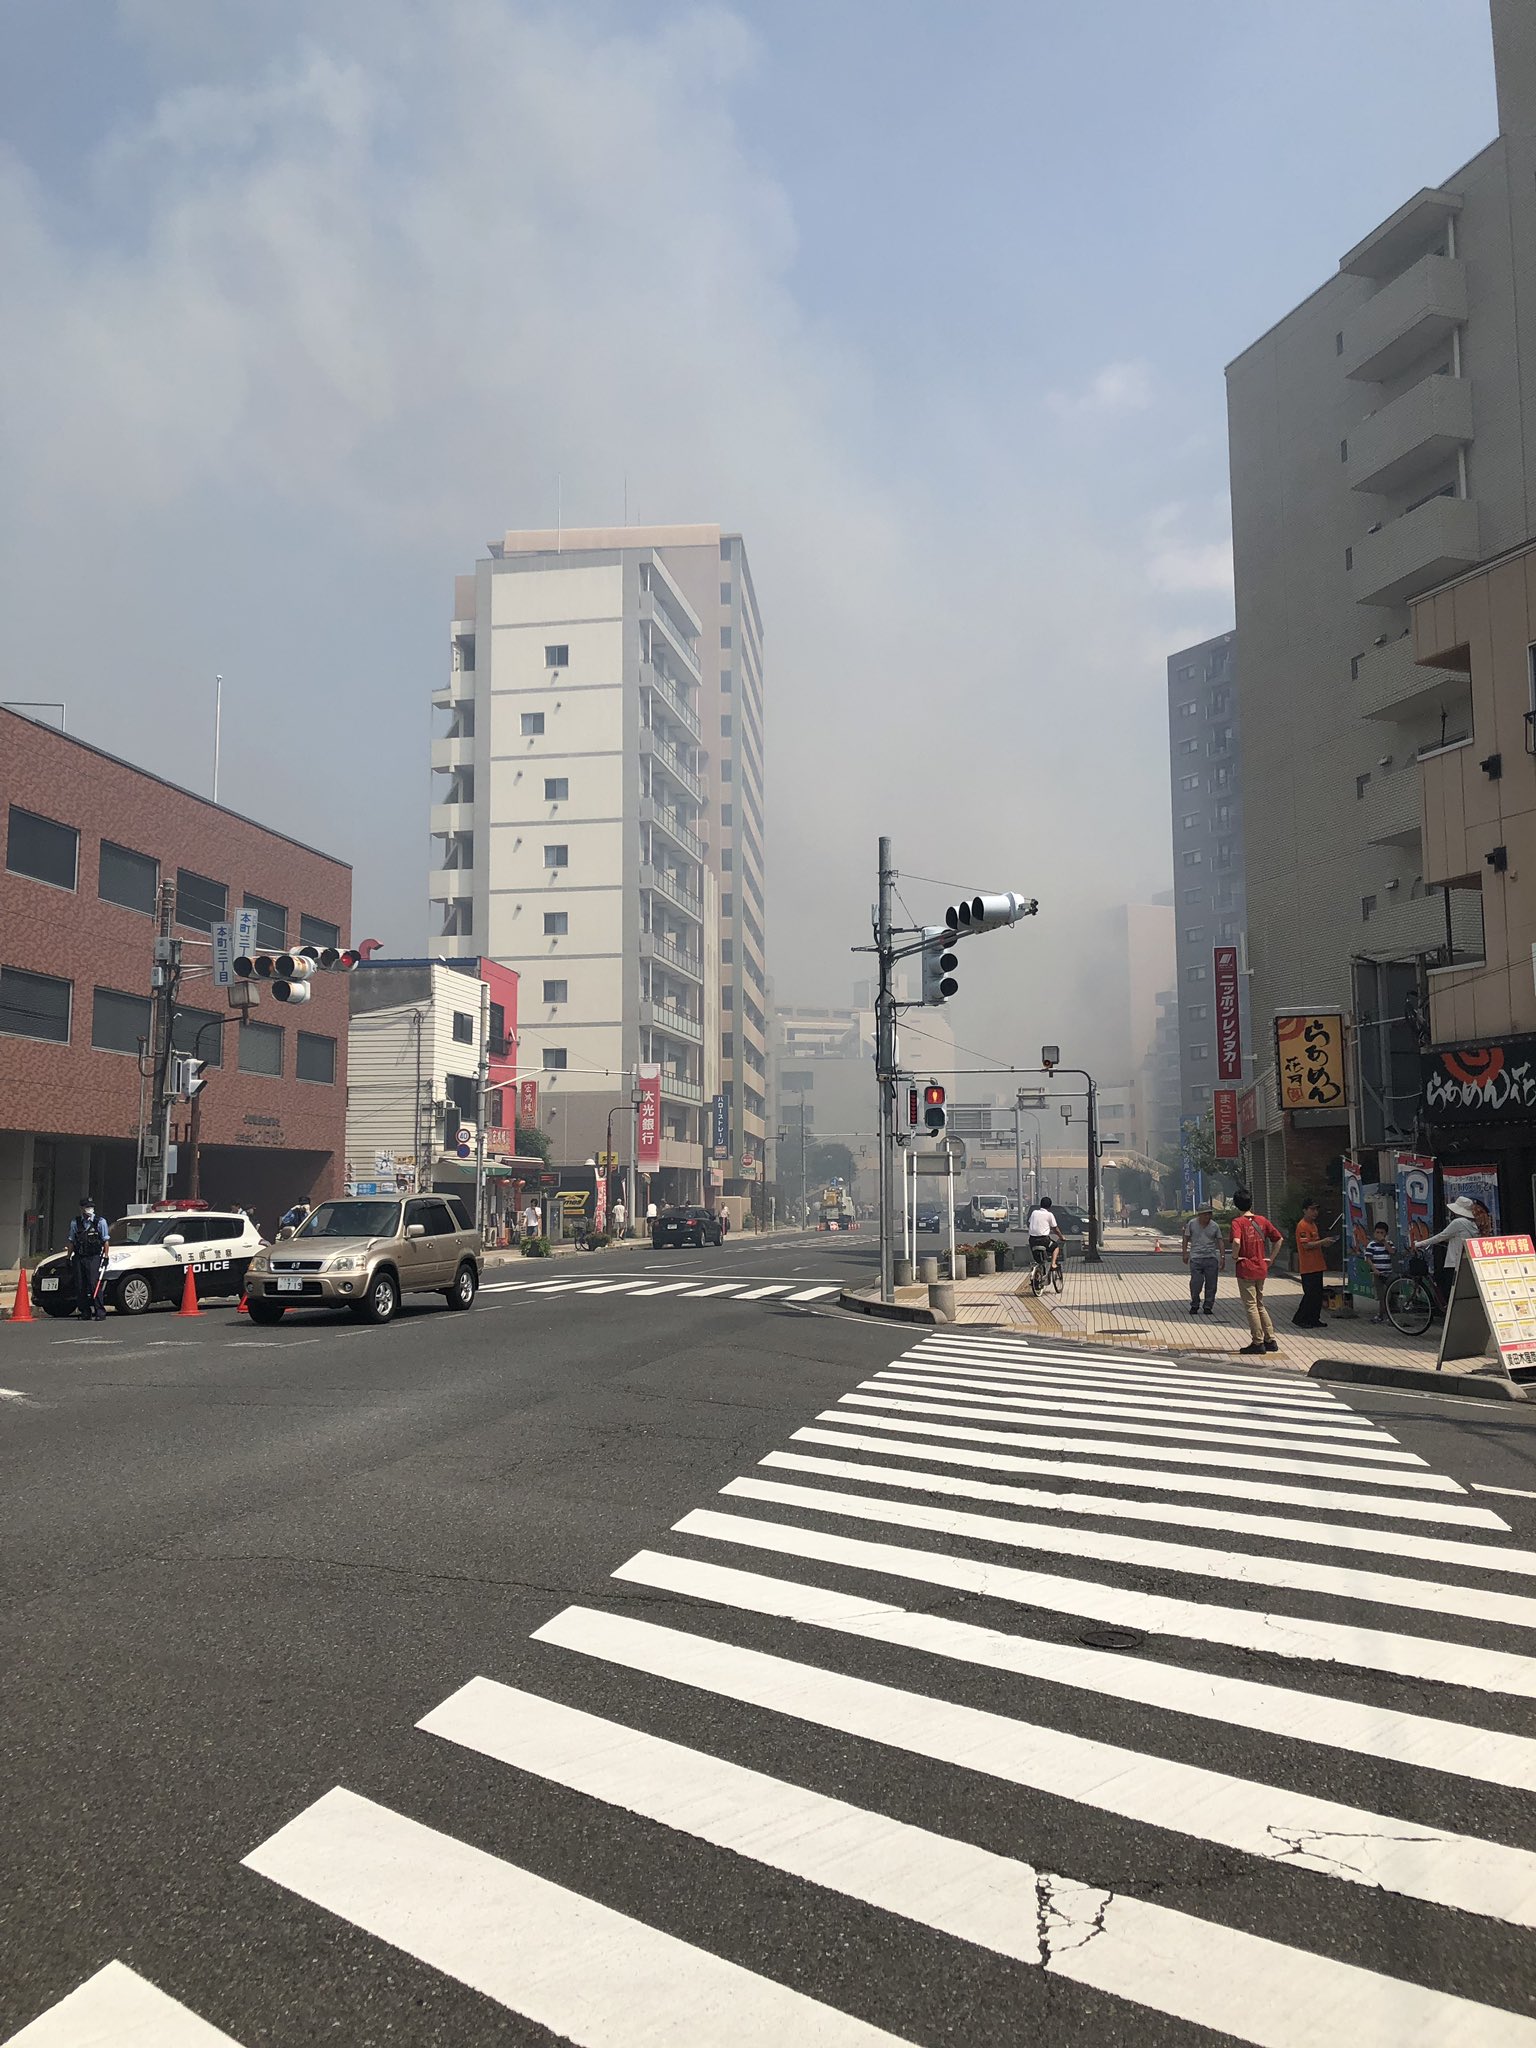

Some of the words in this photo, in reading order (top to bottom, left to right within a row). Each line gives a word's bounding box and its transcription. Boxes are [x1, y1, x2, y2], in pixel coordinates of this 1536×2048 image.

[216, 926, 229, 982] 本町三丁目
[239, 912, 252, 957] 本町三丁
[1219, 974, 1237, 1073] ニッポンレンタカー
[1304, 1019, 1342, 1104] らあめん
[459, 1132, 468, 1140] 40
[641, 1090, 655, 1145] 大光銀行
[1219, 1094, 1234, 1145] まごころ堂
[183, 1260, 230, 1275] POLICE
[1481, 1238, 1530, 1255] 物件情報
